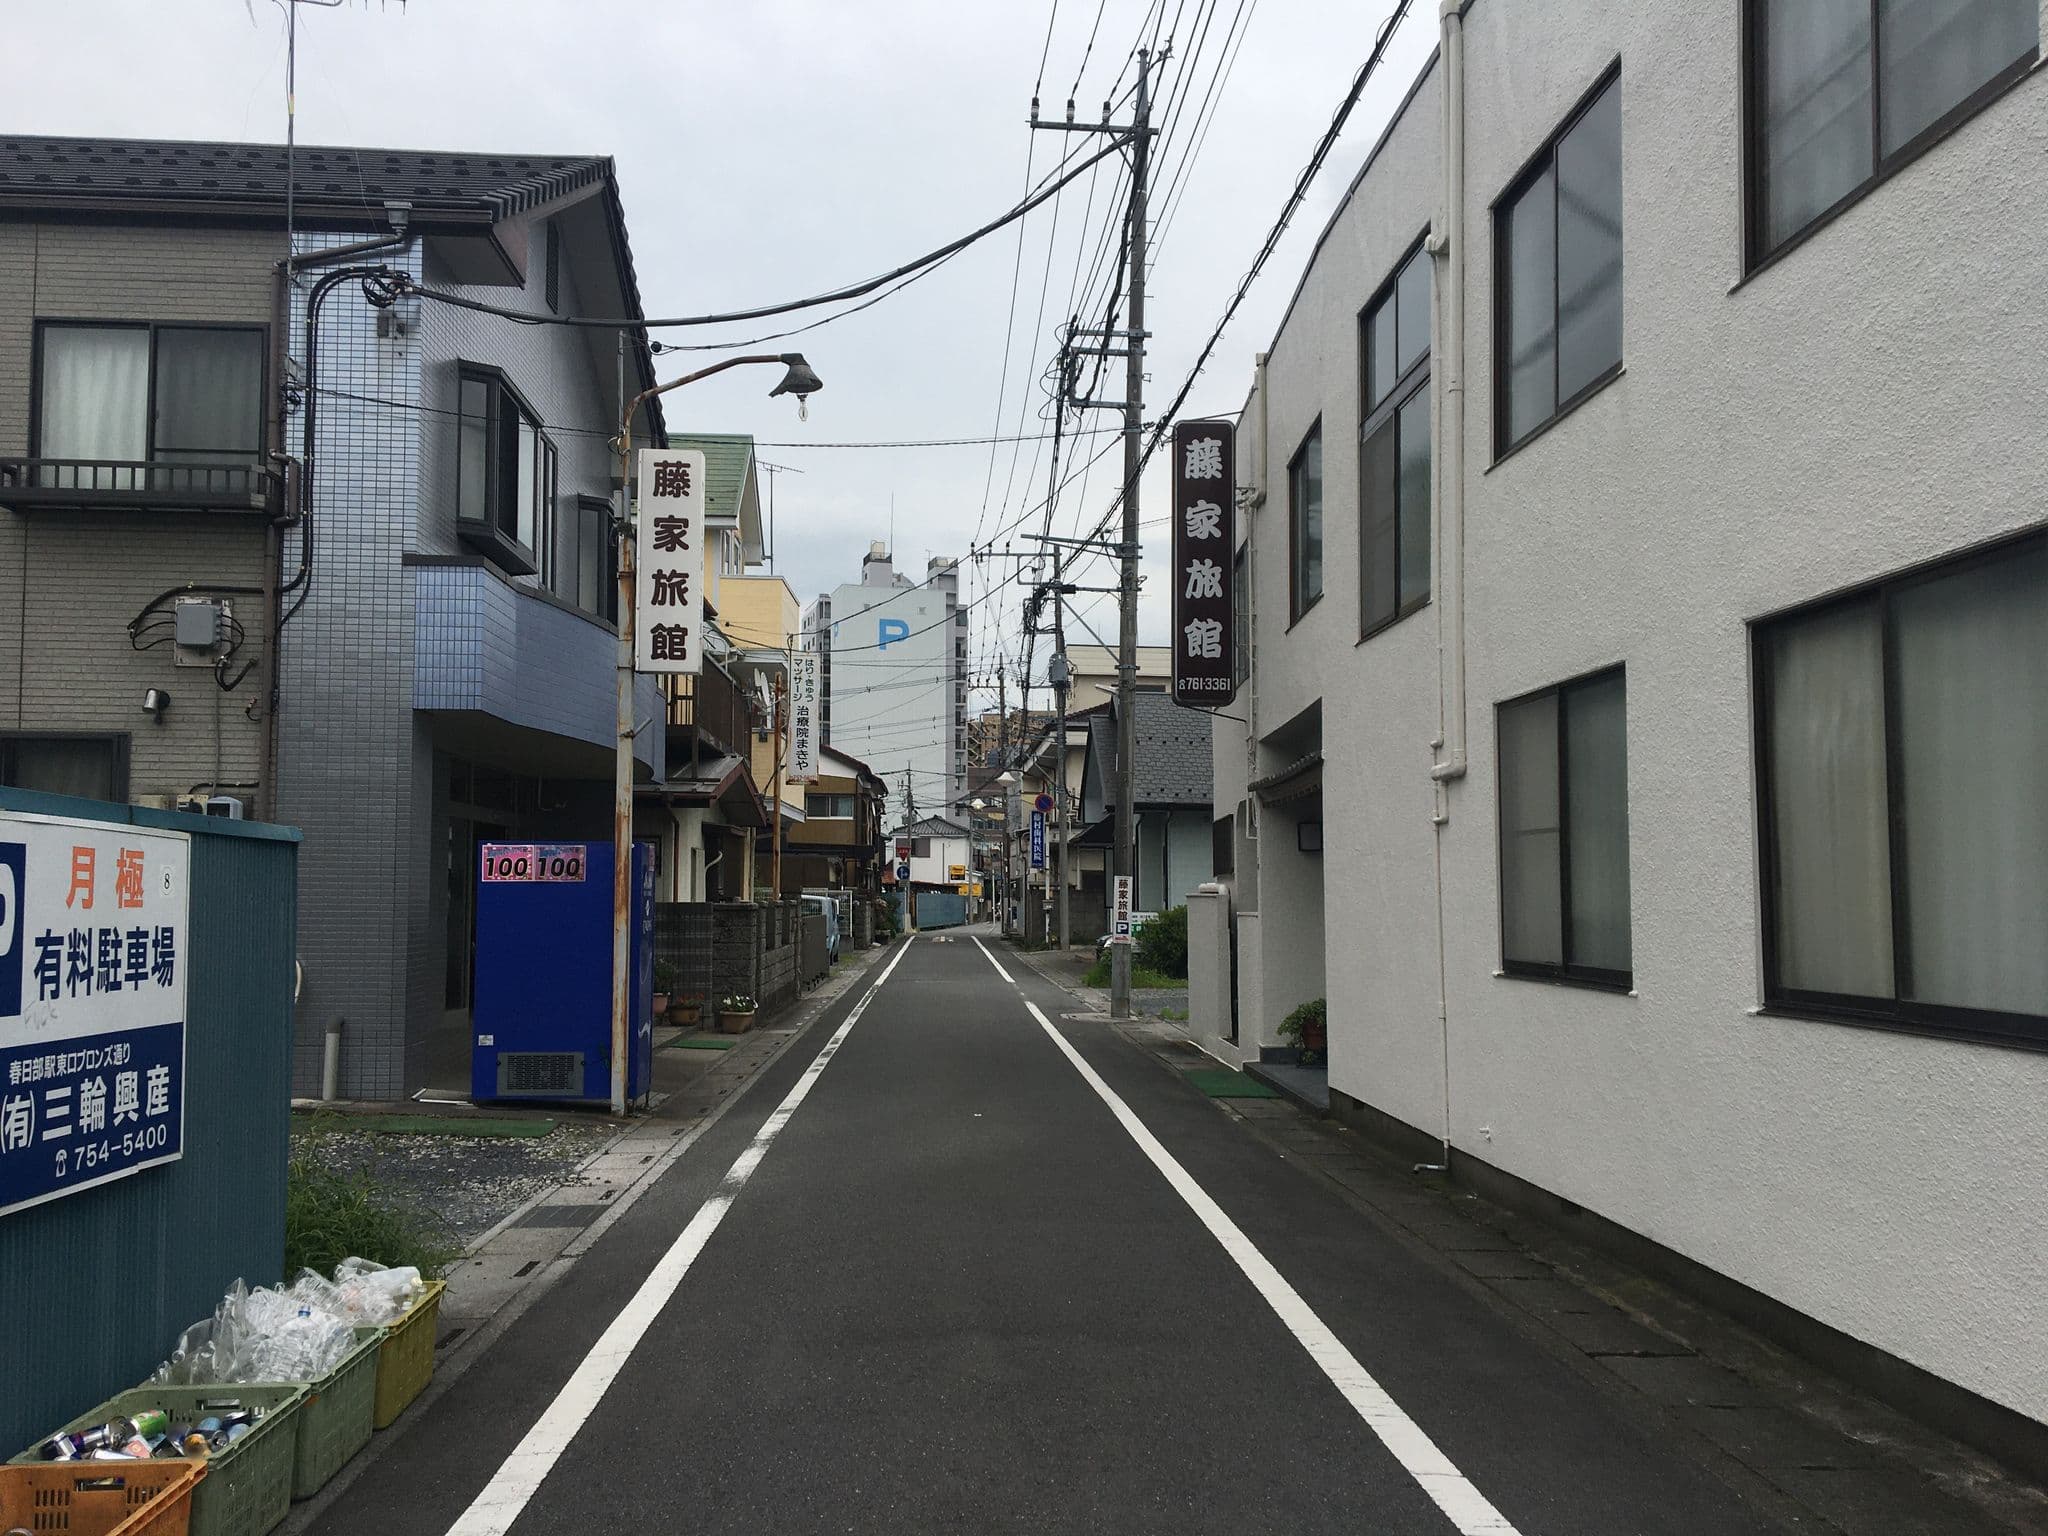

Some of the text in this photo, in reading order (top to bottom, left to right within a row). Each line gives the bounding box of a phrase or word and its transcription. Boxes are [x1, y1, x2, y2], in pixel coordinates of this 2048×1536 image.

[650, 460, 691, 660] 藤家旅館
[1184, 436, 1223, 658] 藤家旅館
[879, 618, 910, 651] P
[793, 658, 803, 702] マッサージ
[65, 846, 145, 909] 月極
[163, 873, 170, 890] 8
[486, 857, 529, 877] 100
[538, 857, 581, 877] 100
[1117, 923, 1128, 933] P
[33, 925, 176, 1002] 有料駐車場
[75, 1124, 167, 1172] 754-5400
